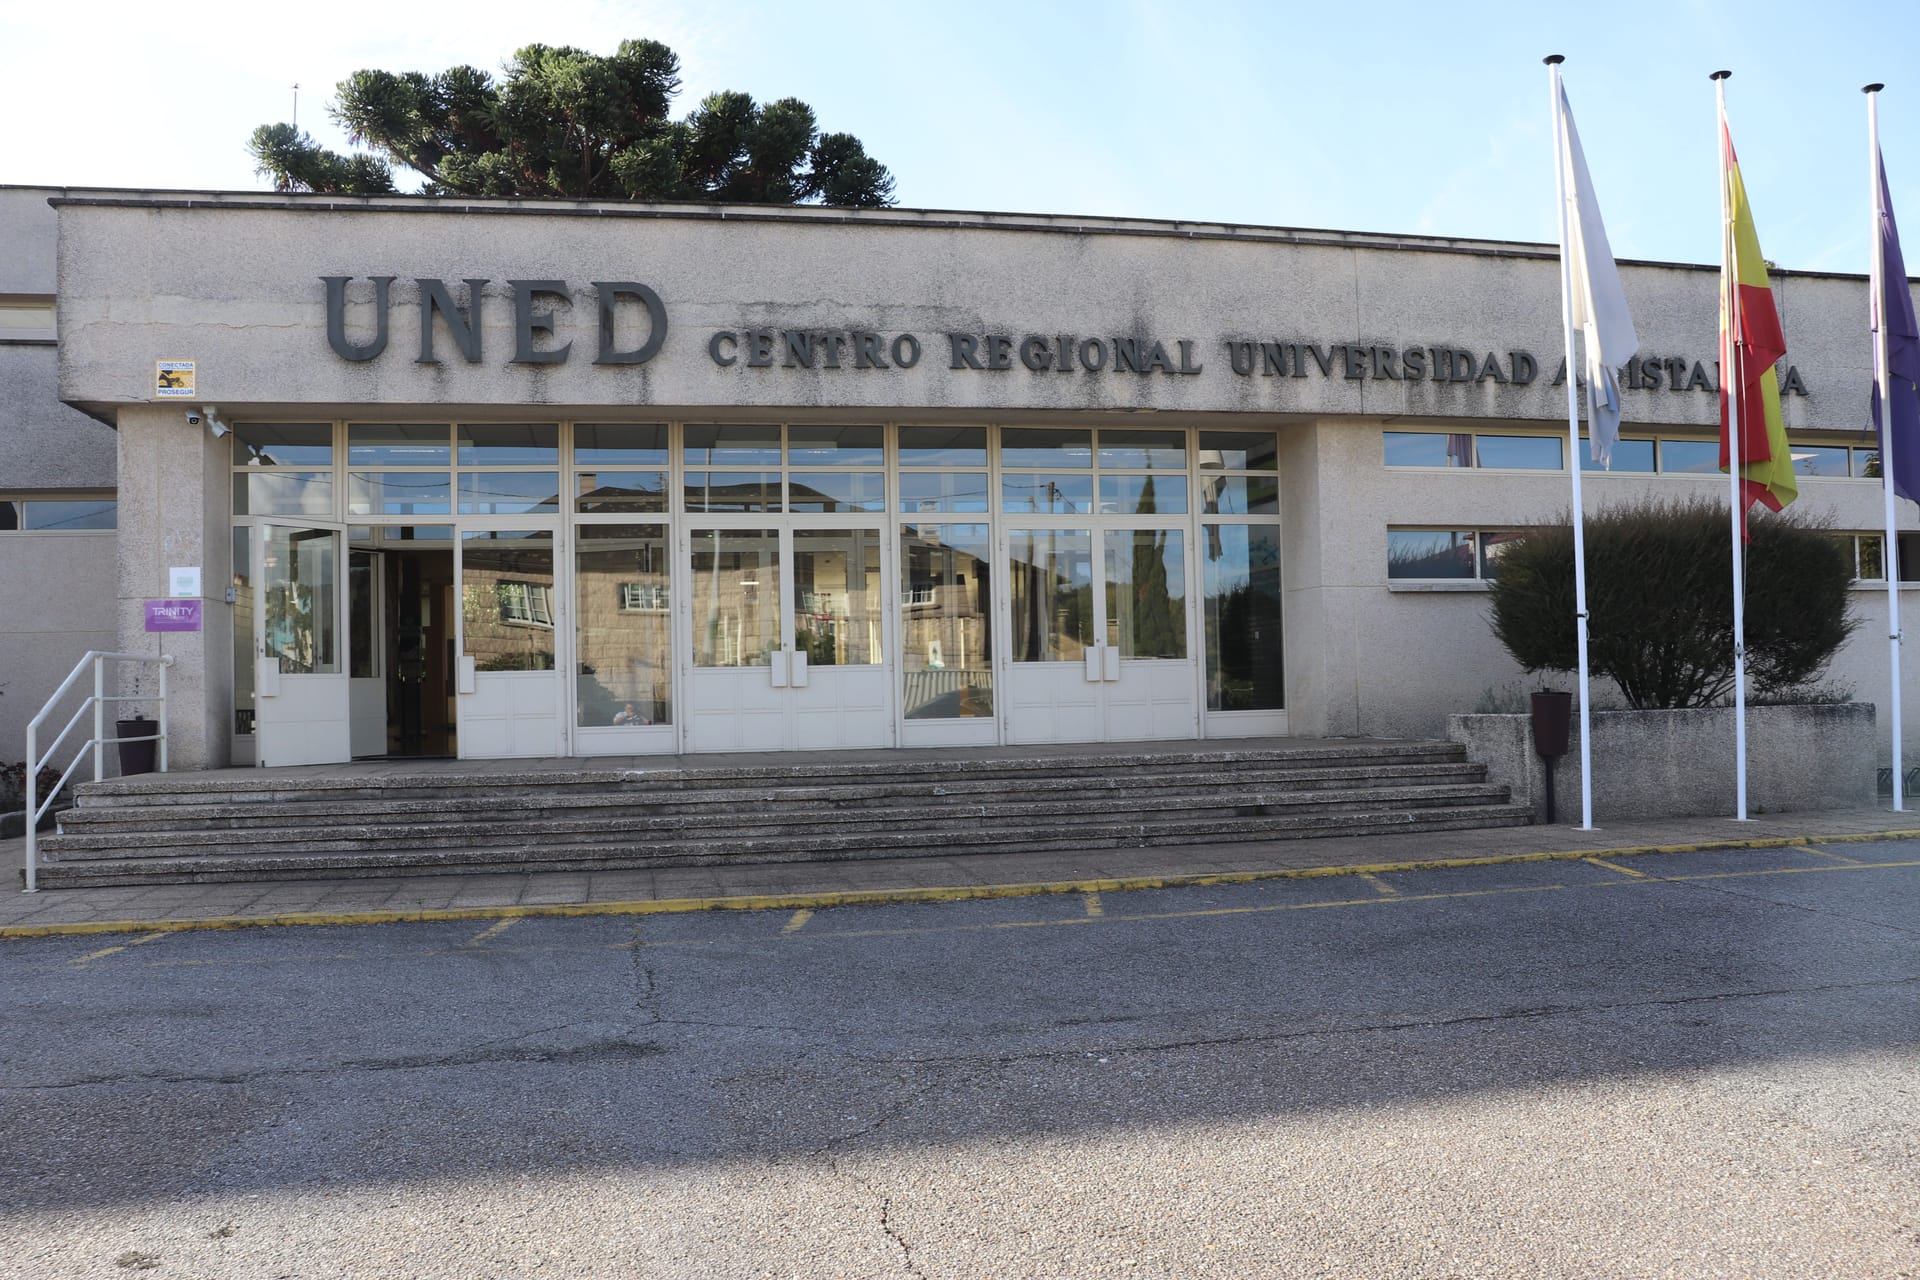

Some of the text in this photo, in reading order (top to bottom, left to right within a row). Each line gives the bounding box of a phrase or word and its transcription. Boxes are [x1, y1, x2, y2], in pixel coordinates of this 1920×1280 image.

[318, 276, 668, 365] UNED
[709, 331, 922, 369] CENTRO
[949, 333, 1203, 375] REGIONAL
[1227, 341, 1538, 385] UNIVERSIDAD
[152, 607, 194, 617] TRINITY
